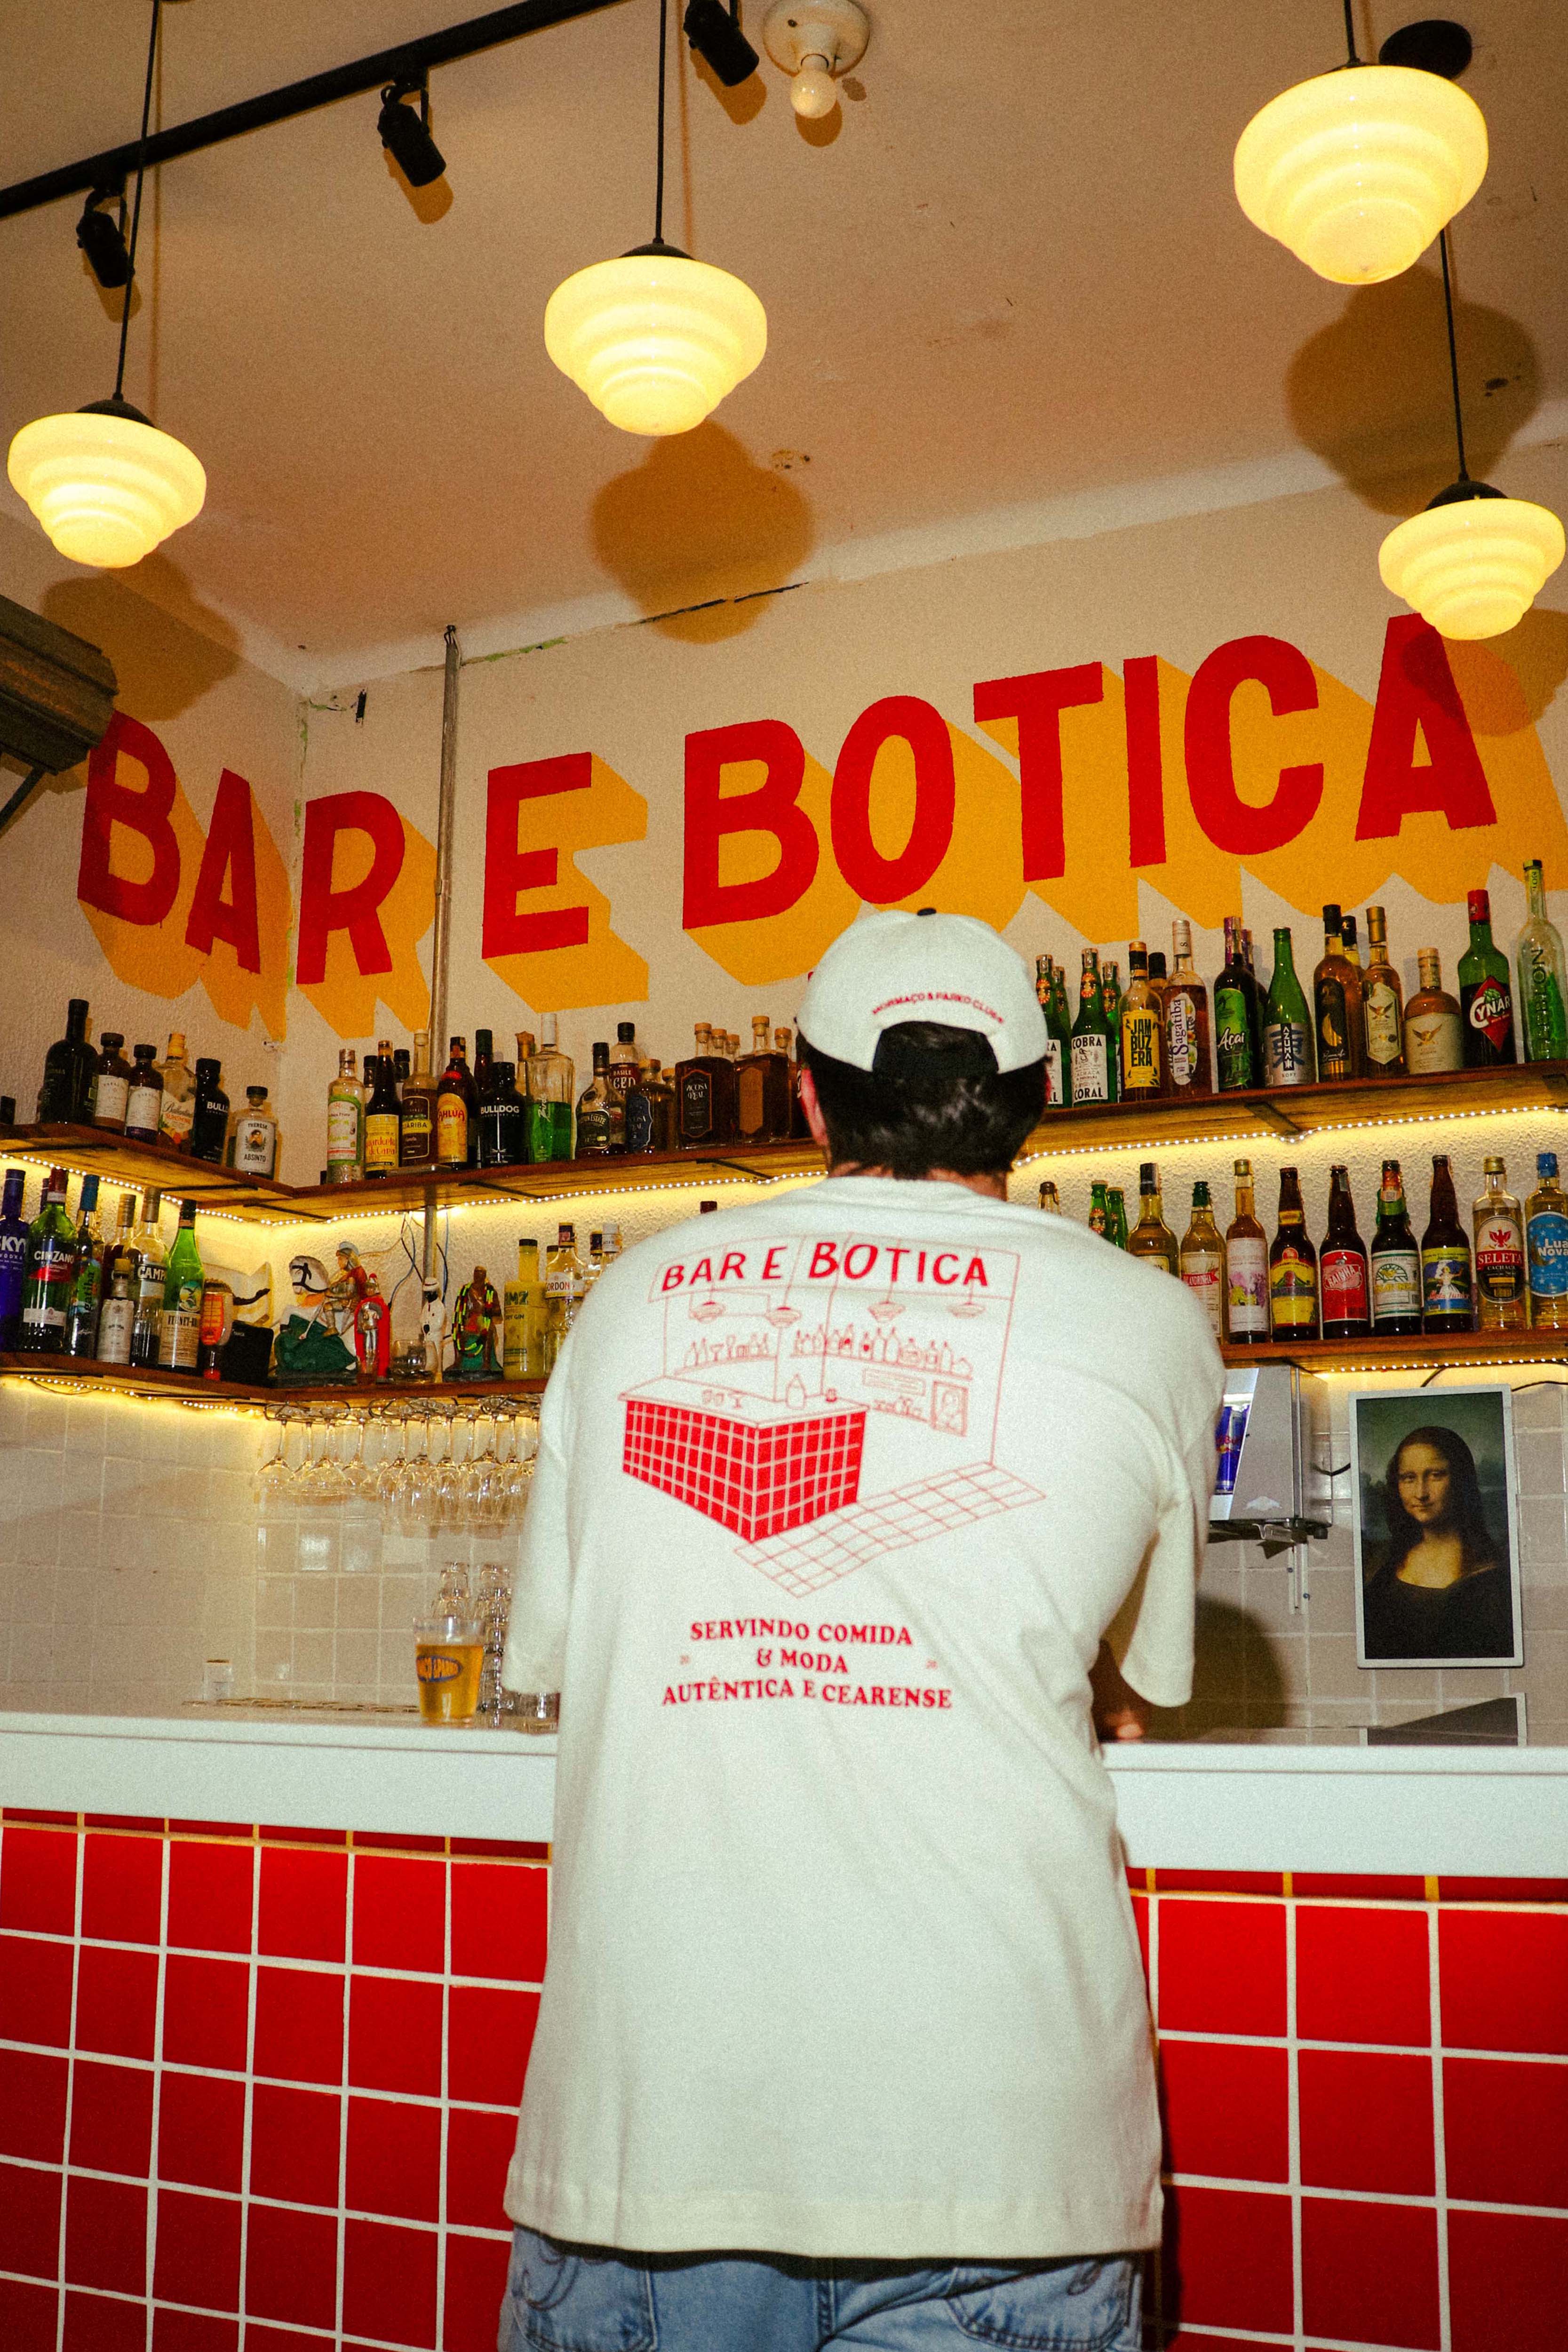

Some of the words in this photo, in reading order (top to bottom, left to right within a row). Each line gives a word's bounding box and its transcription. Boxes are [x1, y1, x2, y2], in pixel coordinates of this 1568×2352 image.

[77, 710, 406, 985] BAR
[482, 752, 592, 959] E
[683, 612, 1498, 930] BOTICA
[1470, 995, 1510, 1029] CYNAR
[1130, 1018, 1151, 1035] JAM
[1171, 1000, 1189, 1055] Sagatiba
[1073, 1036, 1102, 1049] COBRA
[1131, 1035, 1152, 1051] BUZ
[1131, 1050, 1152, 1067] ERA
[1075, 1087, 1103, 1100] CORAL
[480, 1105, 520, 1115] BULLDOG
[244, 1153, 266, 1162] ABSINTO
[0, 1235, 26, 1254] KYY
[1537, 1247, 1568, 1256] Nova
[1544, 1238, 1568, 1248] Lua
[34, 1250, 74, 1264] CINZANO
[1478, 1253, 1522, 1264] SELETA
[661, 1252, 746, 1292] BAR
[762, 1247, 788, 1280] E
[808, 1242, 988, 1287] BOTICA
[690, 1618, 810, 1641] SERVINDO
[818, 1624, 913, 1645] COMIDA
[756, 1647, 772, 1668] &
[781, 1648, 849, 1674] MODA
[662, 1675, 795, 1706] AUTÊNTICA
[803, 1679, 816, 1698] E
[821, 1684, 952, 1708] CEARENSE
